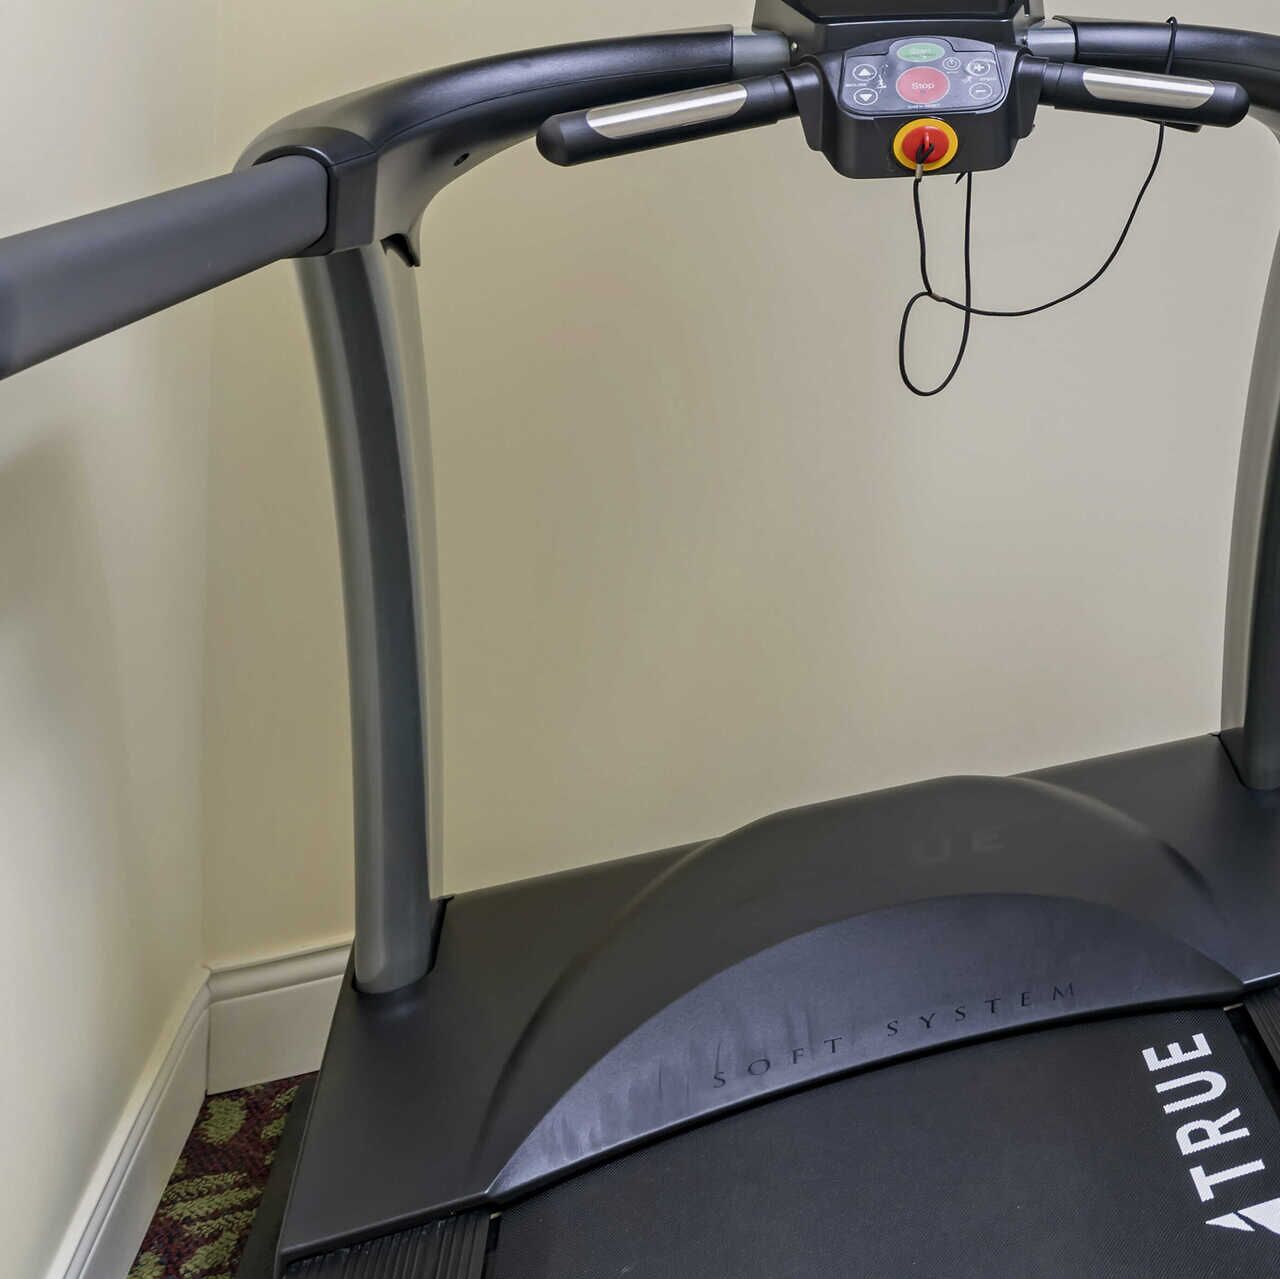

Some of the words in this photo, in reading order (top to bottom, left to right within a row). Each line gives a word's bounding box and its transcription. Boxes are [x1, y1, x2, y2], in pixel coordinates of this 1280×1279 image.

[911, 81, 935, 91] Stop
[712, 1037, 843, 1089] SOFT
[887, 982, 1075, 1037] SYSTEM
[1142, 1032, 1266, 1203] TRUE
